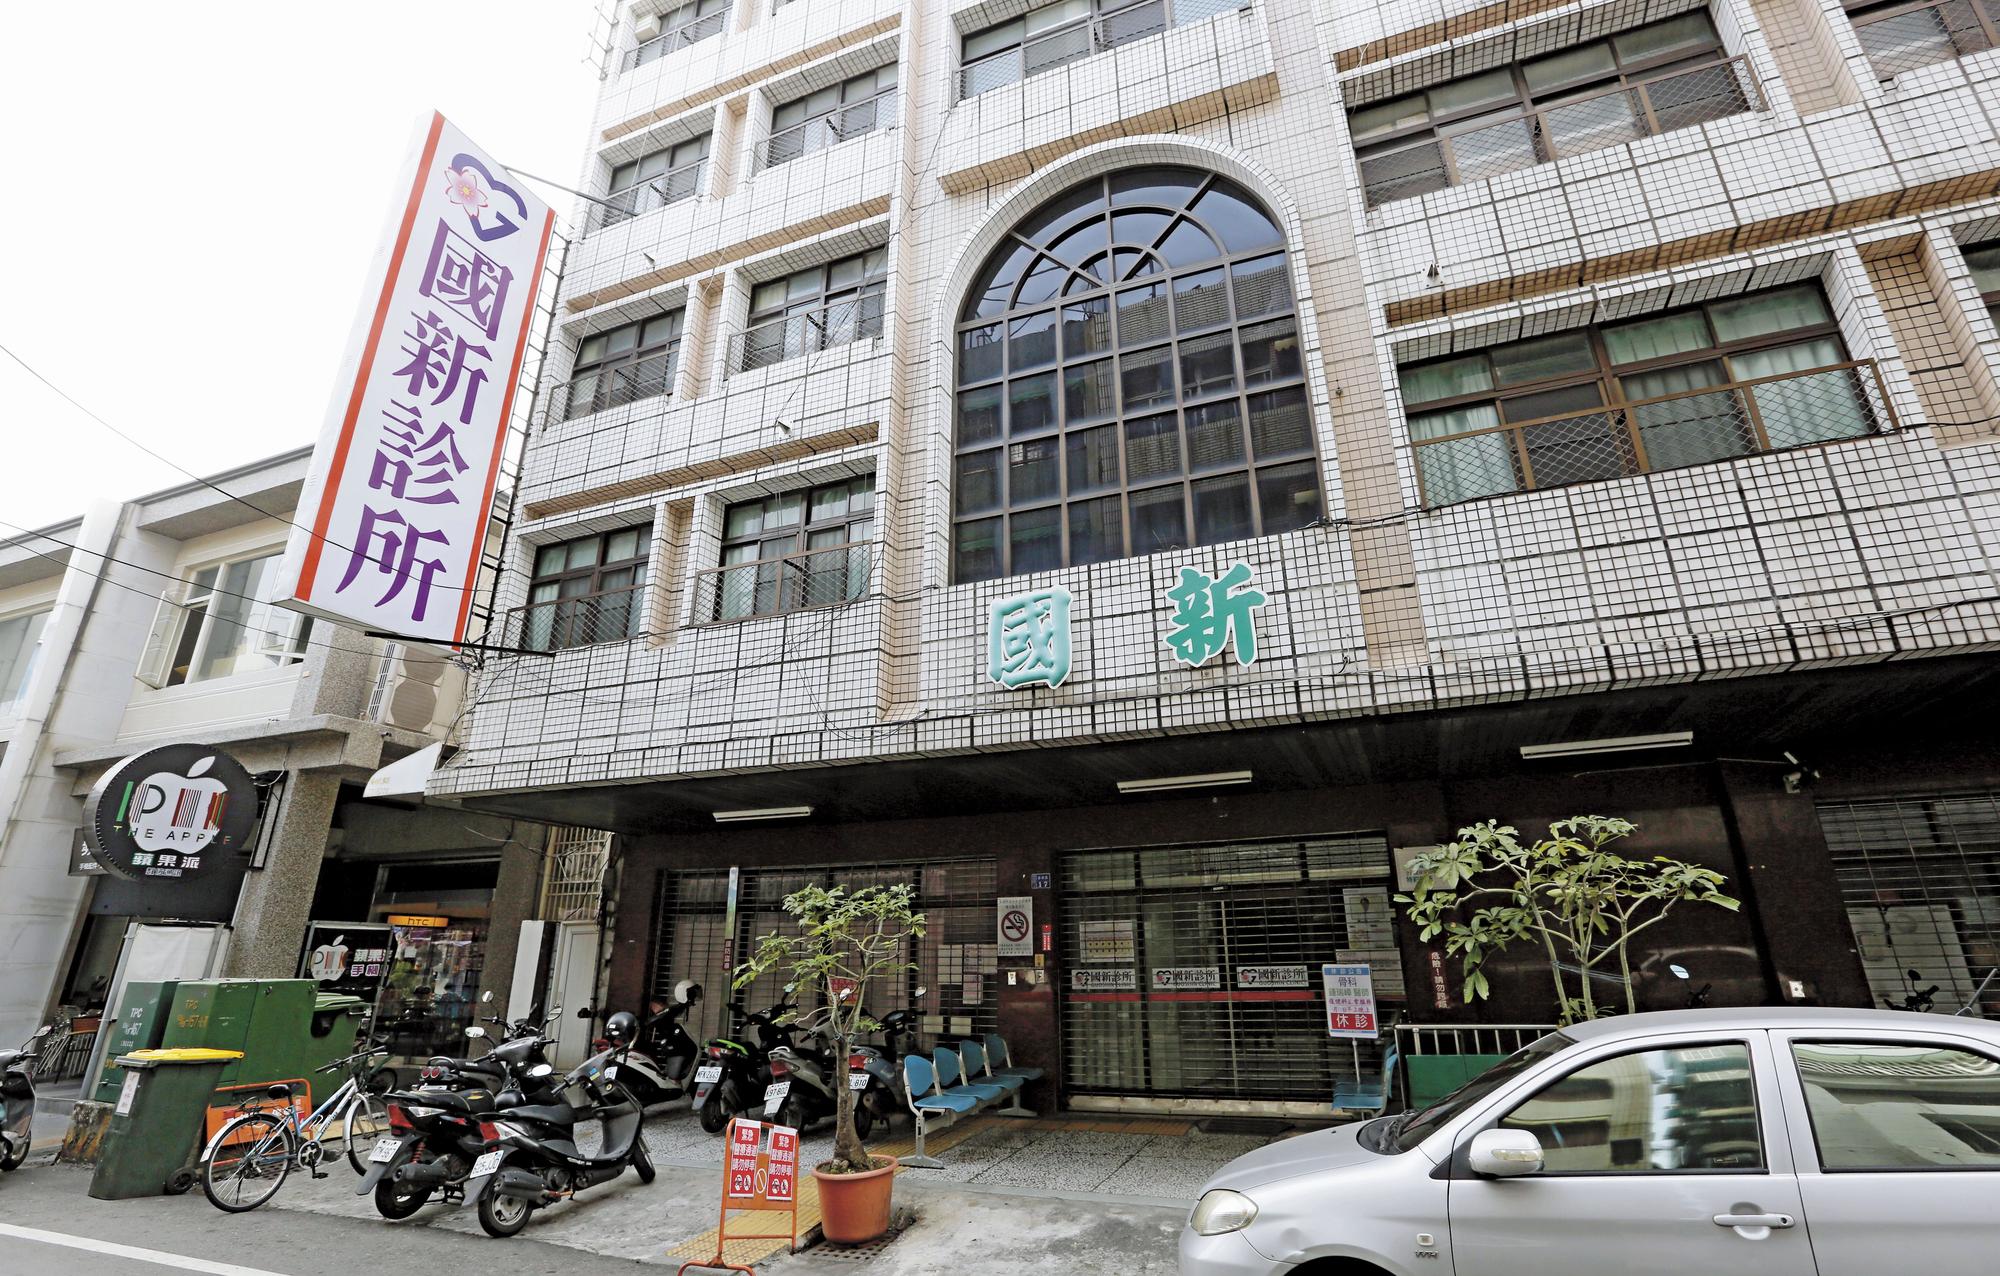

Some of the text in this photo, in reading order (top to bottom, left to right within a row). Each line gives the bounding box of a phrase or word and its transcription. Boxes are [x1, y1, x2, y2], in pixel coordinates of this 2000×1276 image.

[335, 216, 514, 623] 國新診所
[113, 825, 155, 839] THE
[131, 852, 200, 869] 蘋果派
[1090, 970, 1132, 982] 國新診所
[1172, 969, 1216, 982] 國新診所
[1258, 967, 1305, 980] 國新診所
[1338, 976, 1358, 987] 骨科
[130, 1007, 144, 1018] TPC
[1336, 1013, 1369, 1029] 休診
[741, 1128, 754, 1142] 緊急
[777, 1135, 790, 1148] 緊急
[731, 1158, 756, 1171] 請勿停車
[768, 1163, 793, 1177] 請勿停車
